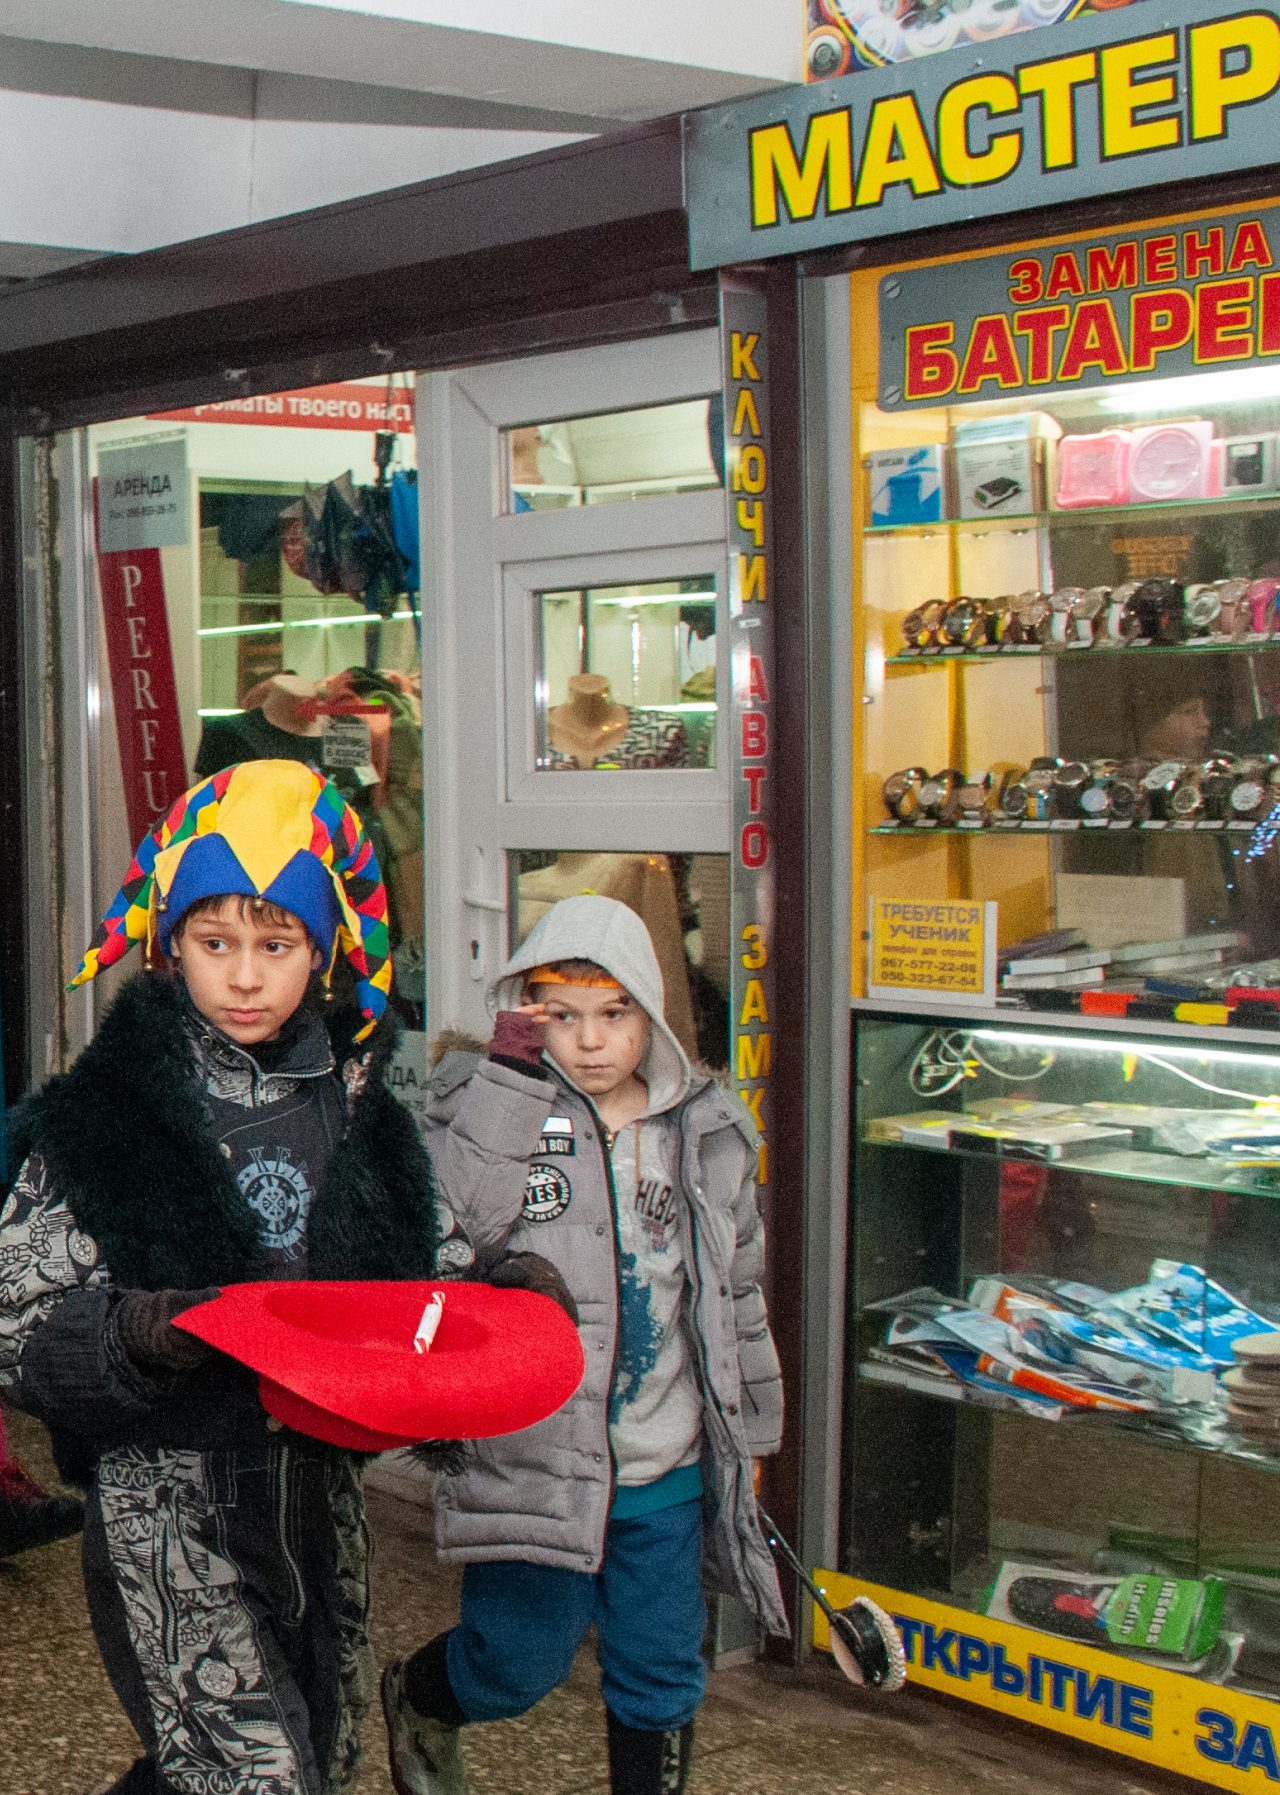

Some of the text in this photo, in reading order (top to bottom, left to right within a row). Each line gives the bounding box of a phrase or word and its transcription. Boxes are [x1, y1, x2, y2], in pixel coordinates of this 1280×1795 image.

[749, 9, 1280, 231] МАСТЕР
[1009, 220, 1272, 304] ЗАМЕНА
[287, 398, 361, 419] твоего
[114, 474, 172, 498] АРЕНДА
[730, 331, 766, 602] КЛЮЧИ
[122, 566, 169, 815] PERFU
[740, 654, 770, 869] АВТО
[881, 903, 979, 925] ТРЕБУЕТСЯ
[889, 925, 971, 942] УЧЕНИК
[549, 1139, 570, 1152] BOY
[525, 1184, 556, 1205] YES
[1145, 1580, 1178, 1644] Insoles
[892, 1614, 1153, 1740] ТКРЫТИЕ
